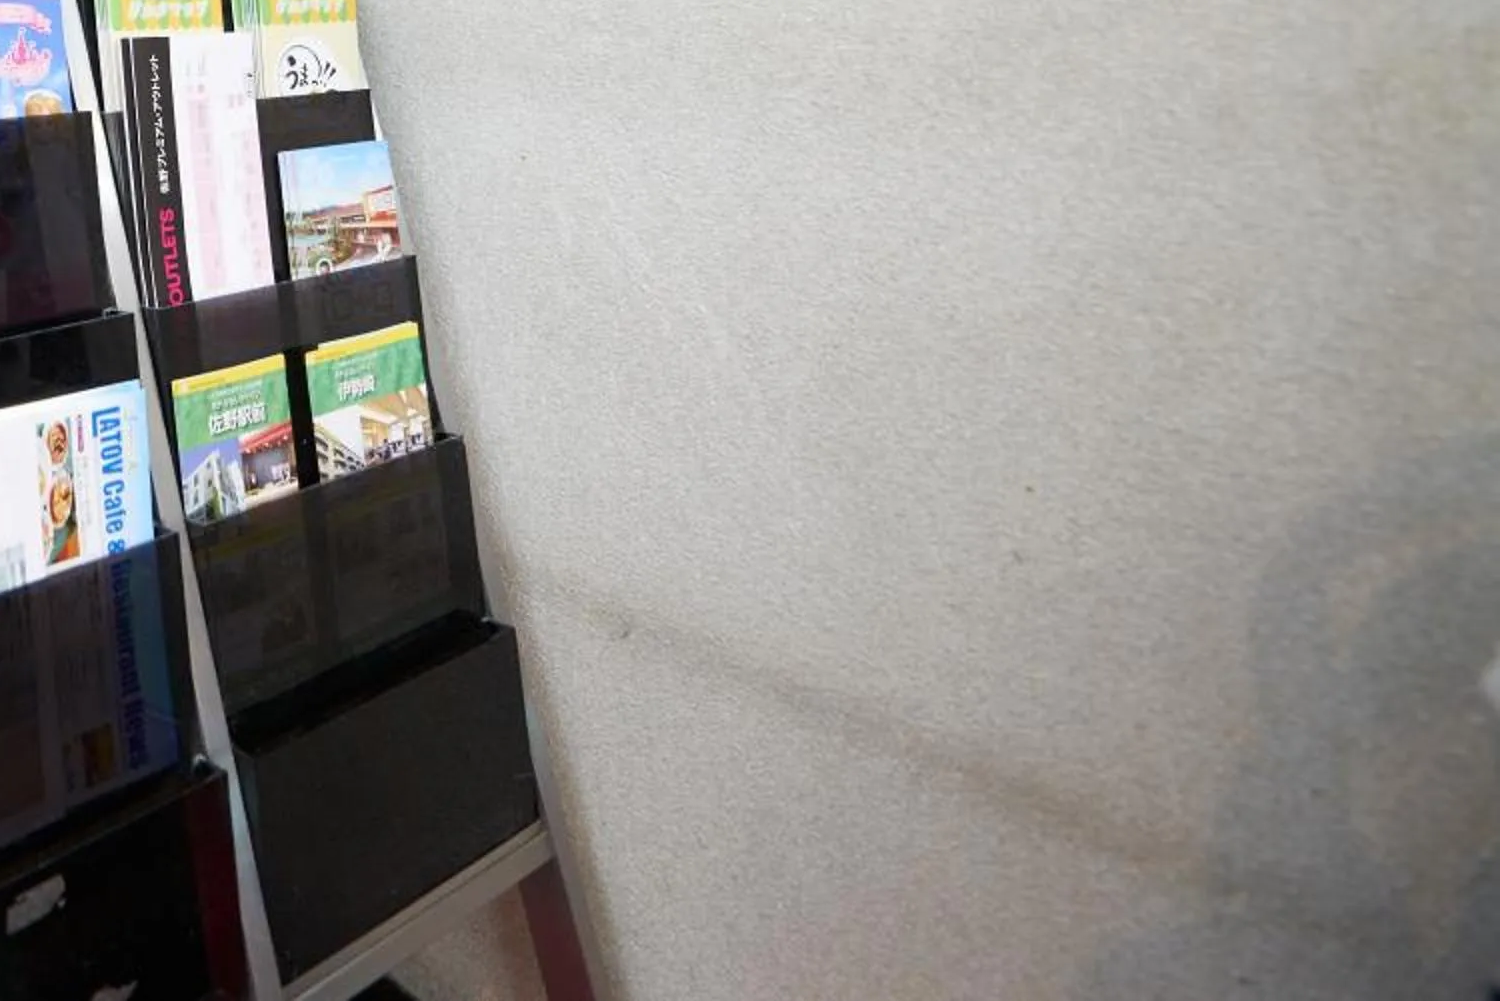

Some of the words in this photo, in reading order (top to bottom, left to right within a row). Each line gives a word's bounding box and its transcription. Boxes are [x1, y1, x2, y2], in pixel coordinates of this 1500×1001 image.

[159, 207, 185, 307] OUTLETS
[92, 405, 123, 472] LATOV
[103, 480, 126, 534] Cafe
